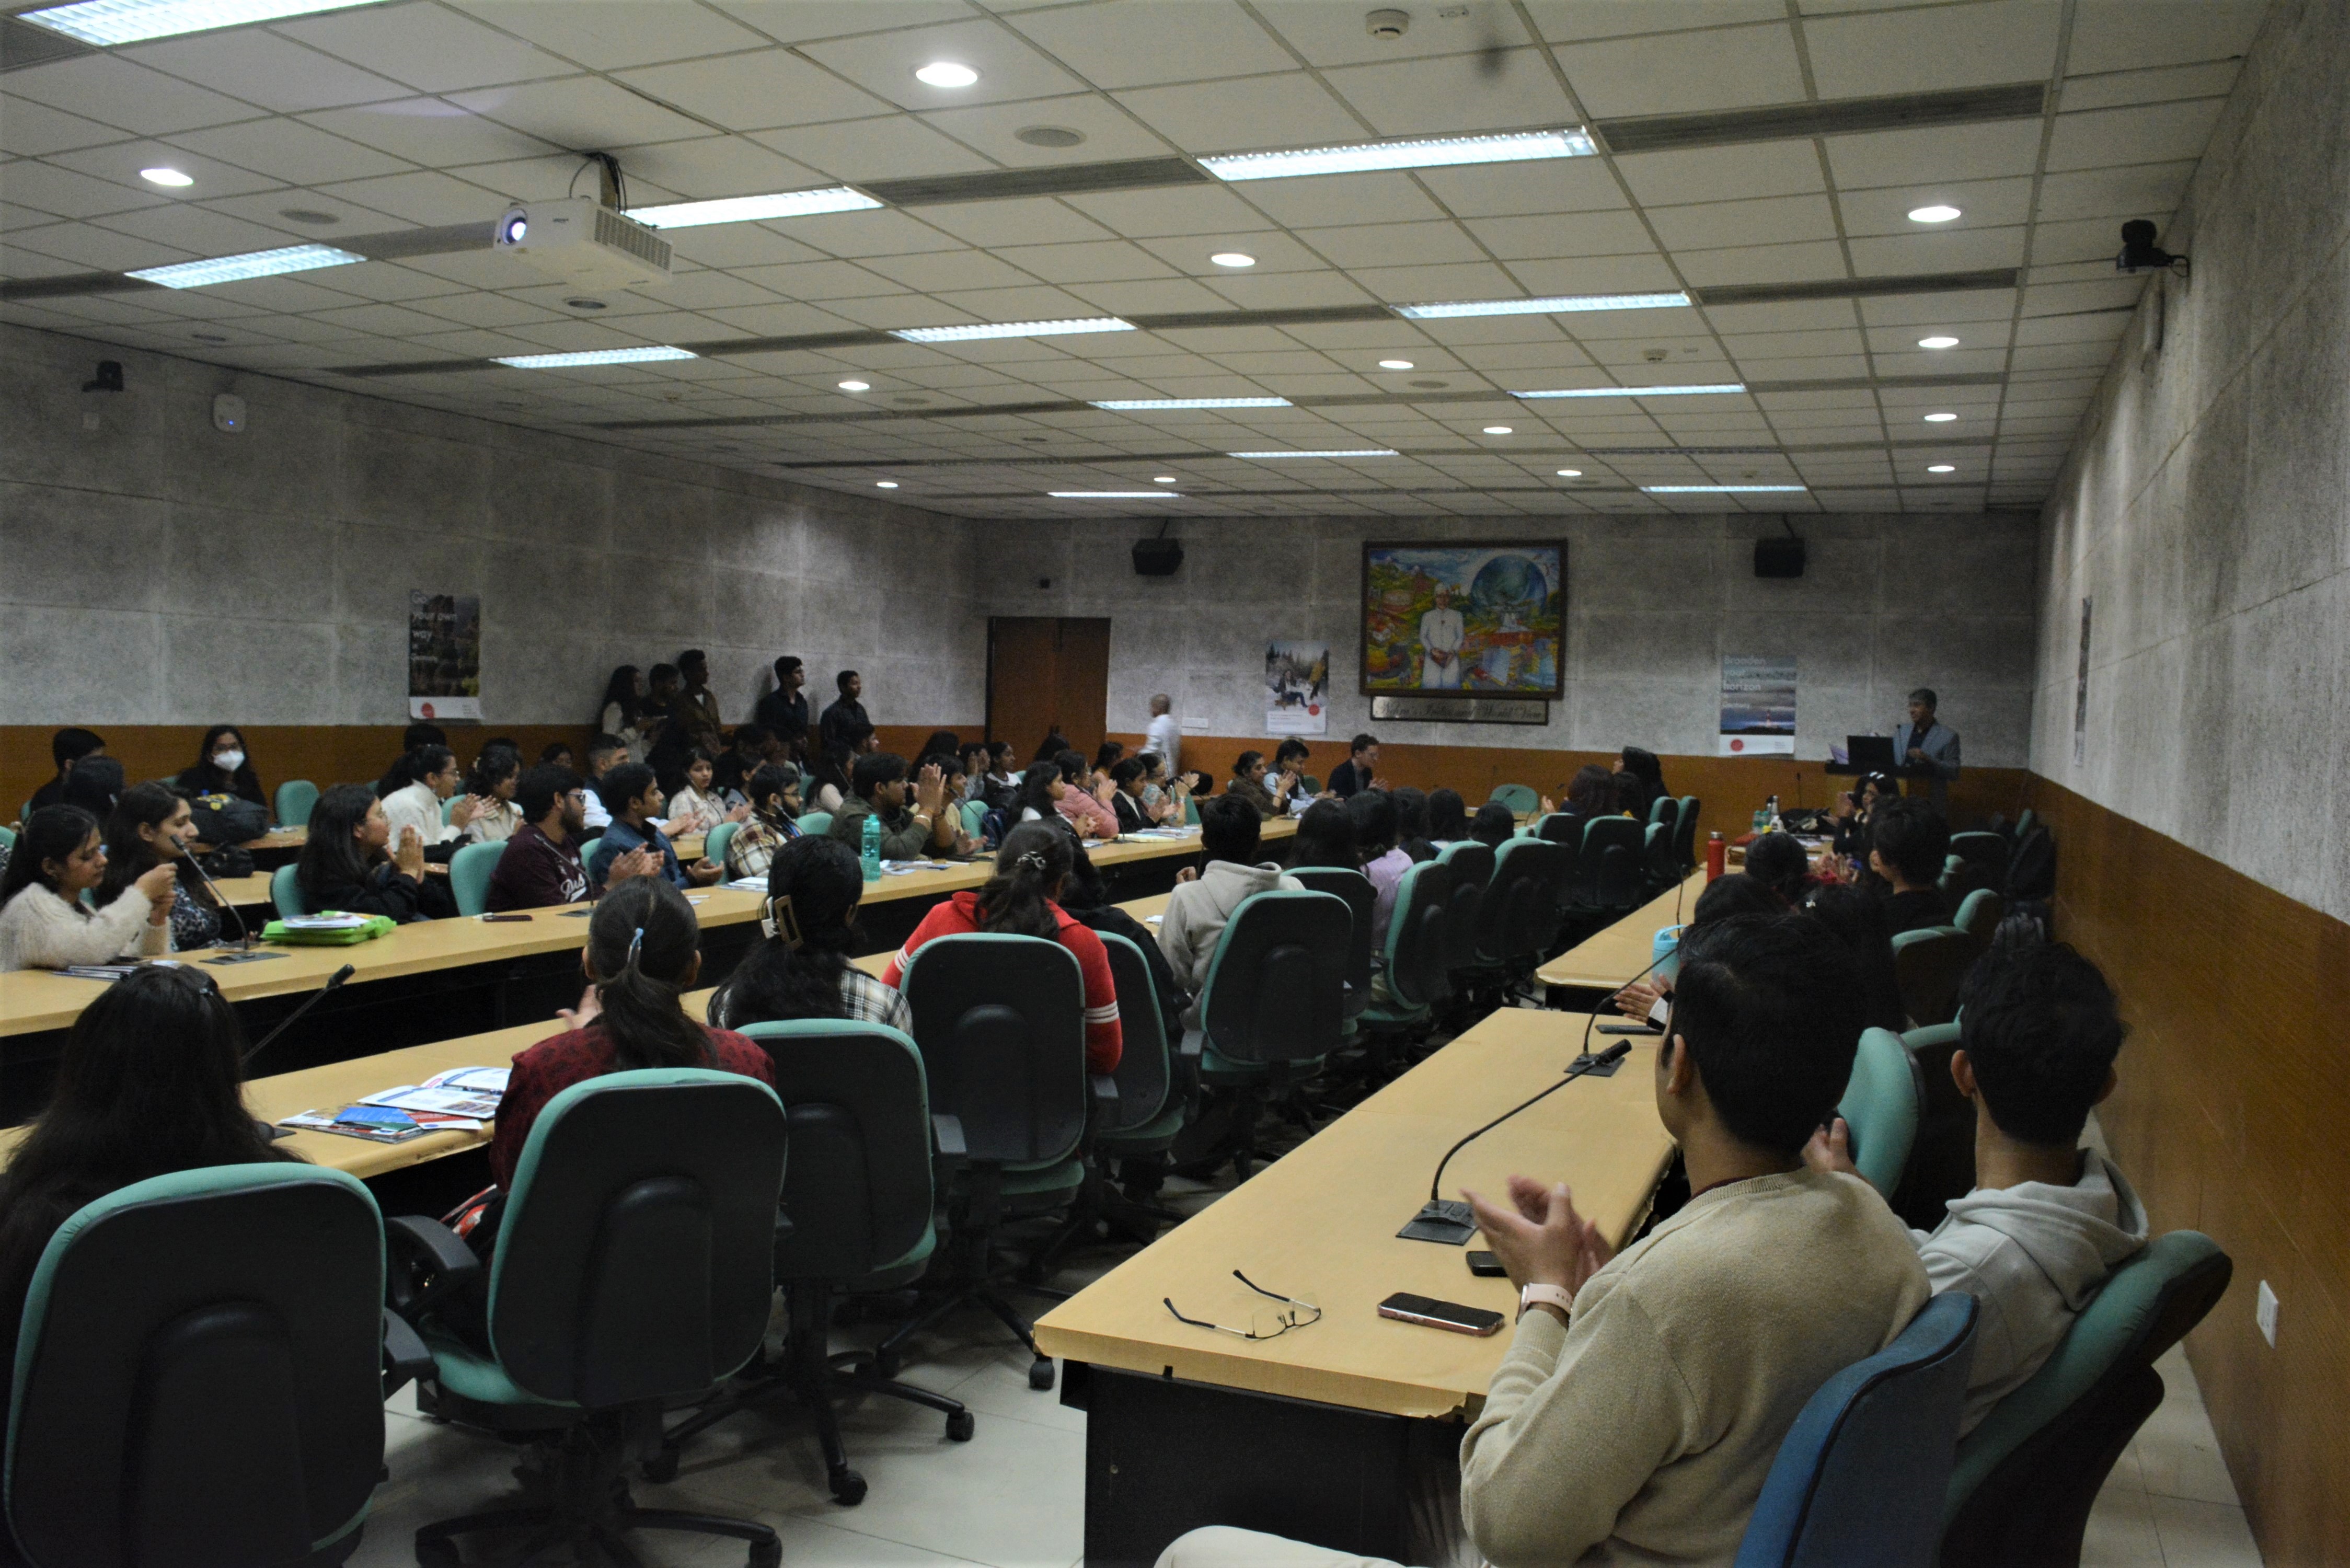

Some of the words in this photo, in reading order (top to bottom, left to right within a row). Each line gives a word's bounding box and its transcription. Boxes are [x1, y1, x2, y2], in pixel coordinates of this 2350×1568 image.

[411, 591, 427, 604] Go
[412, 630, 433, 642] way
[1724, 655, 1767, 665] Broaden
[1723, 679, 1761, 690] horizon
